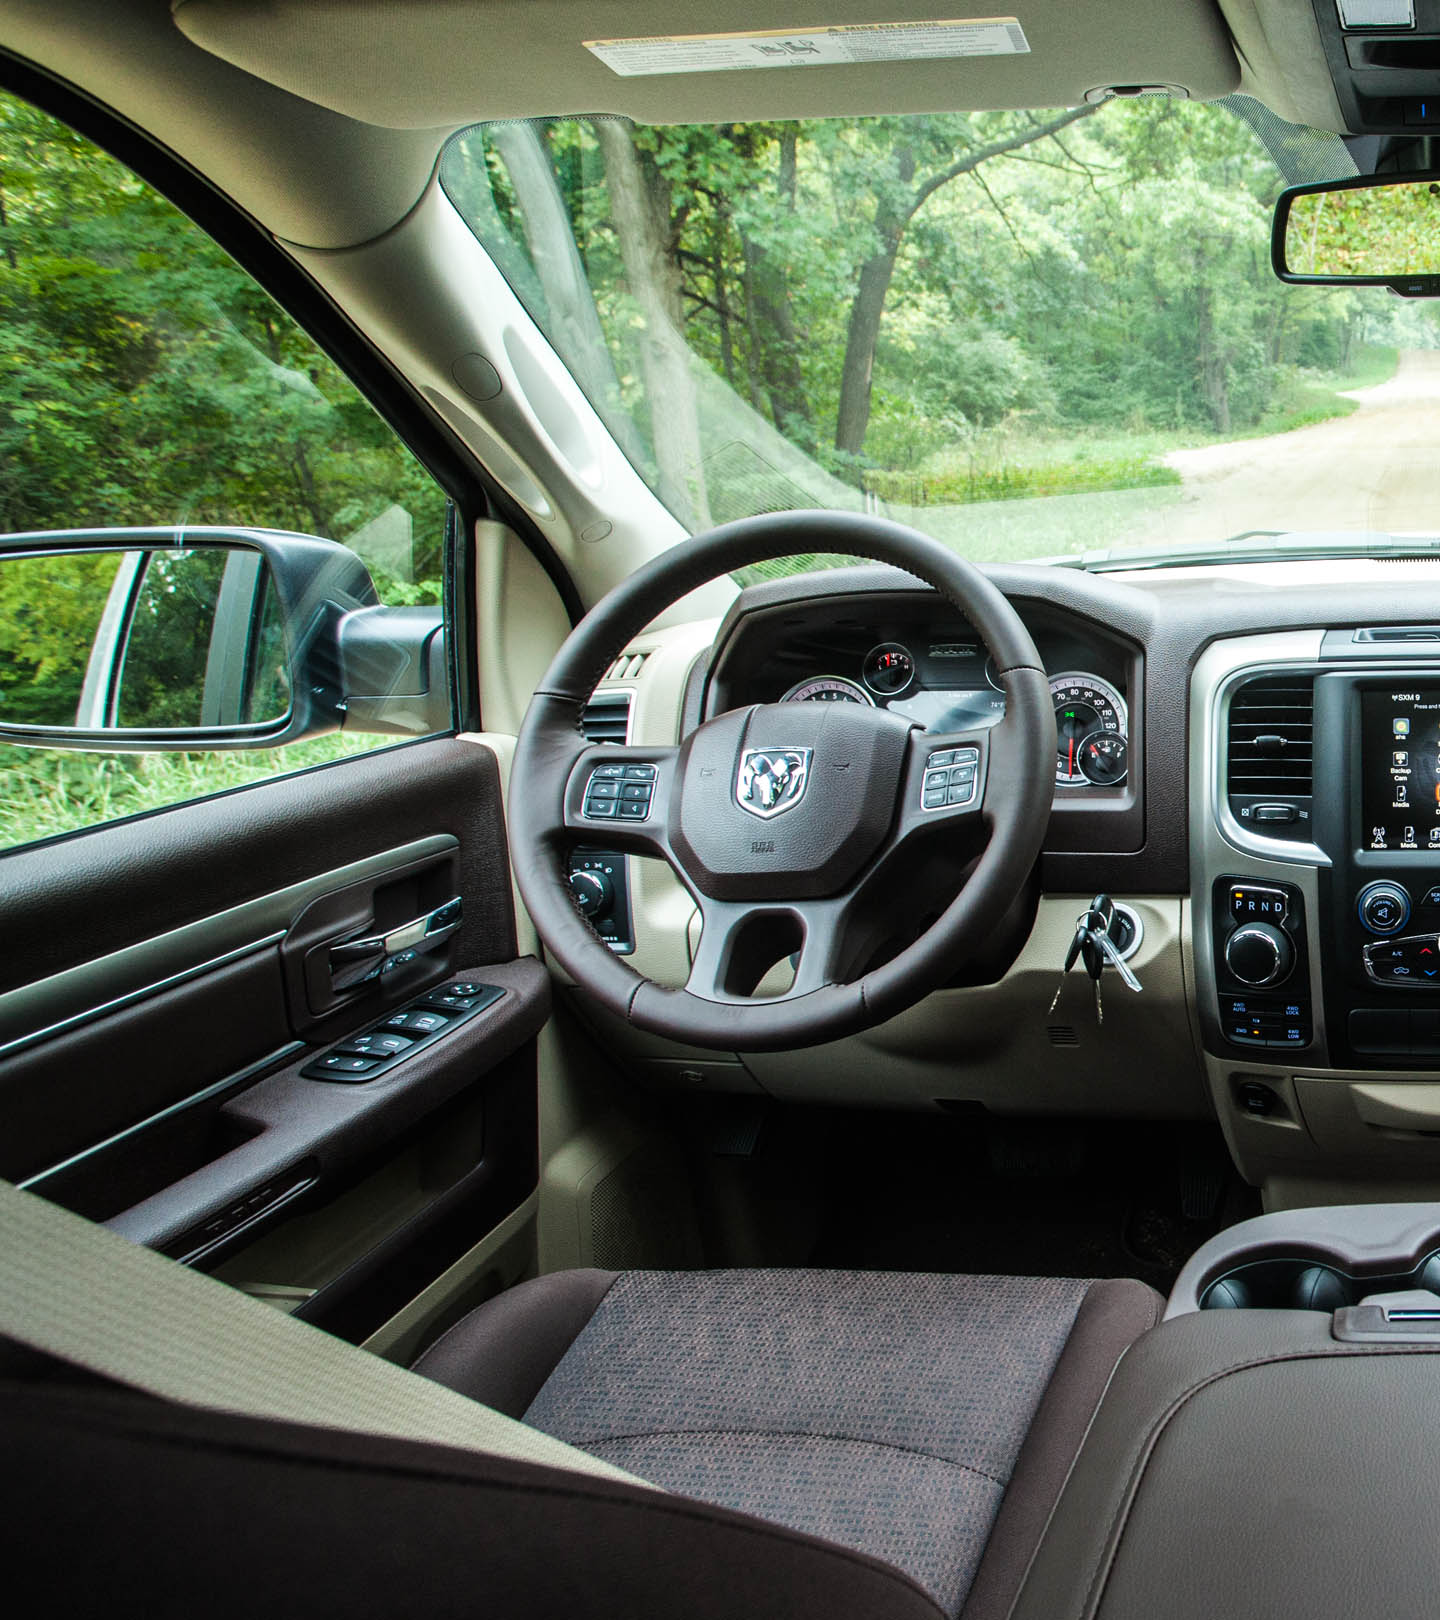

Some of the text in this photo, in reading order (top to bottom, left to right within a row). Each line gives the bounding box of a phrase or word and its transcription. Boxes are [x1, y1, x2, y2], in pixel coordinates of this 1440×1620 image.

[1398, 693, 1414, 701] SXM
[1235, 900, 1282, 912] P R N D
